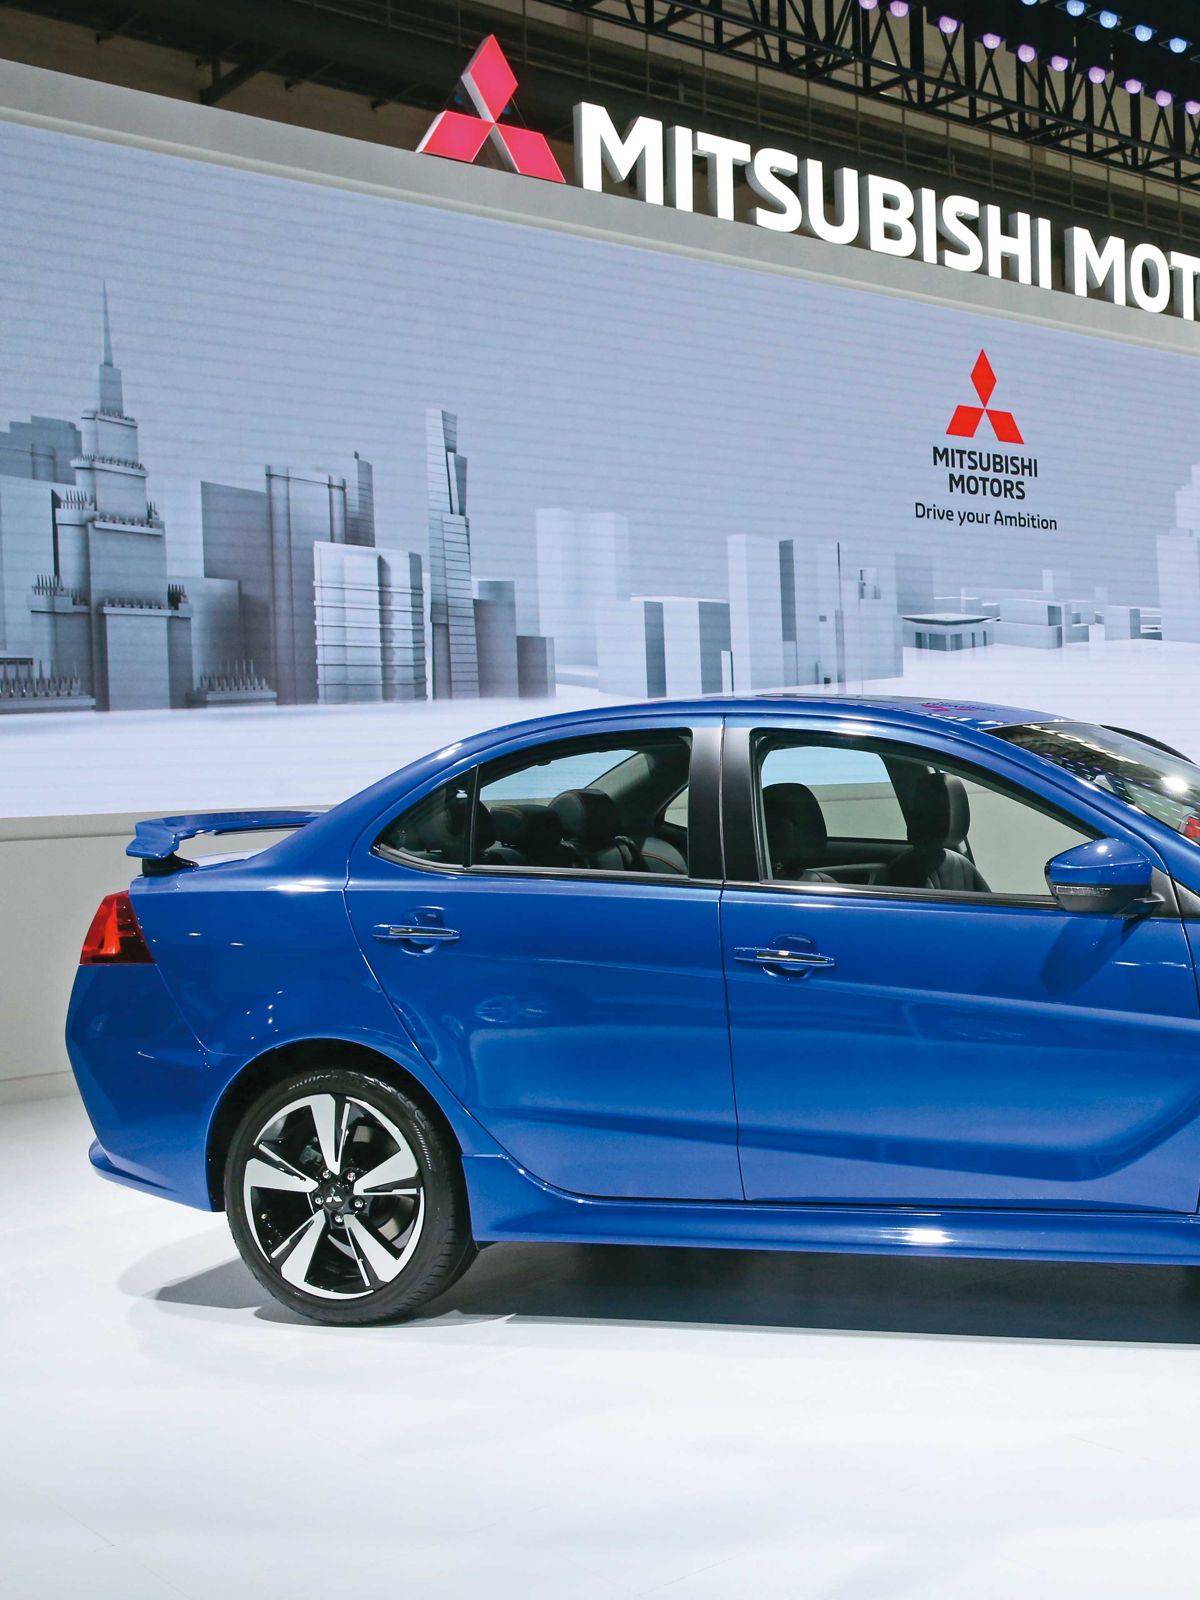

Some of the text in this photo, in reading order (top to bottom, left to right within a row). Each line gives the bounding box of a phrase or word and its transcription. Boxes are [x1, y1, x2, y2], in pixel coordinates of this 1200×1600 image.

[573, 102, 1053, 290] MITSUBISHI
[933, 447, 1038, 477] MITSUBISHI
[949, 474, 1026, 500] MOTORS
[915, 503, 1057, 530] Drive your Ambition
